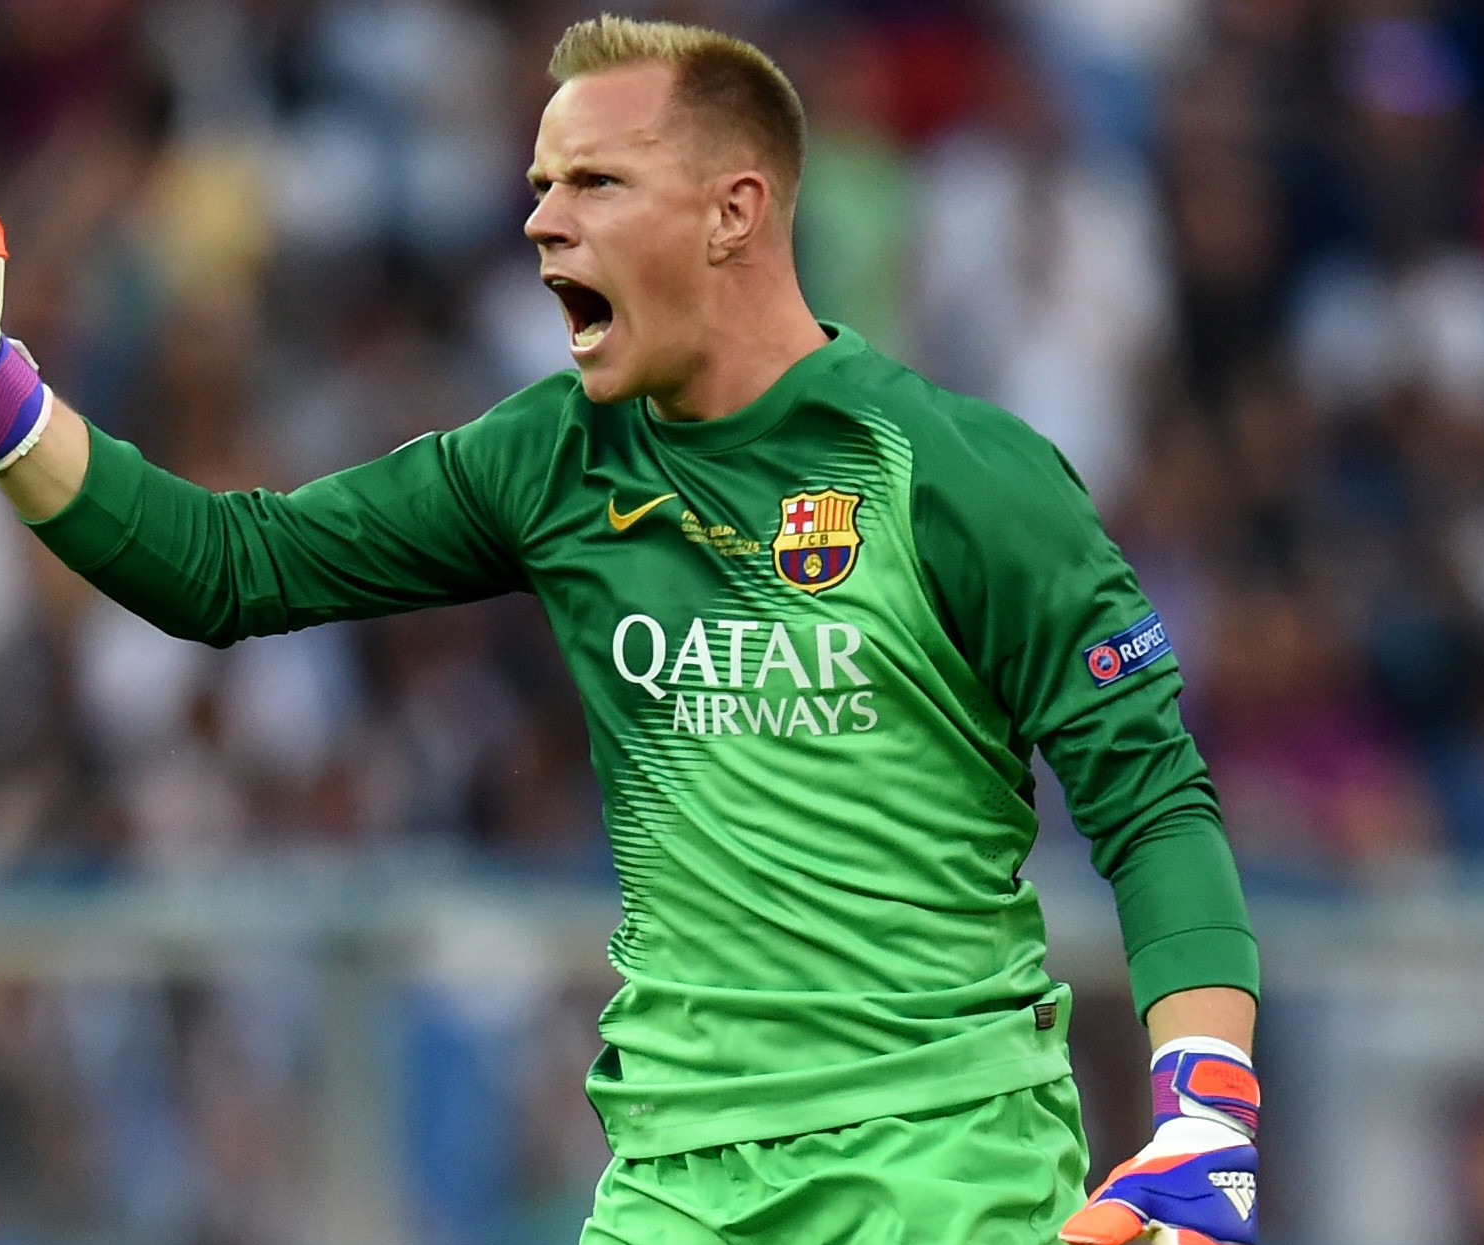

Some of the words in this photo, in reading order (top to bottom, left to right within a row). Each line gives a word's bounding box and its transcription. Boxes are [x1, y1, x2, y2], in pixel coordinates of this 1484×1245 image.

[612, 613, 873, 701] QATAR
[1119, 622, 1166, 663] RESPECT
[672, 690, 879, 738] AIRWAYS
[1207, 1171, 1257, 1189] didas
